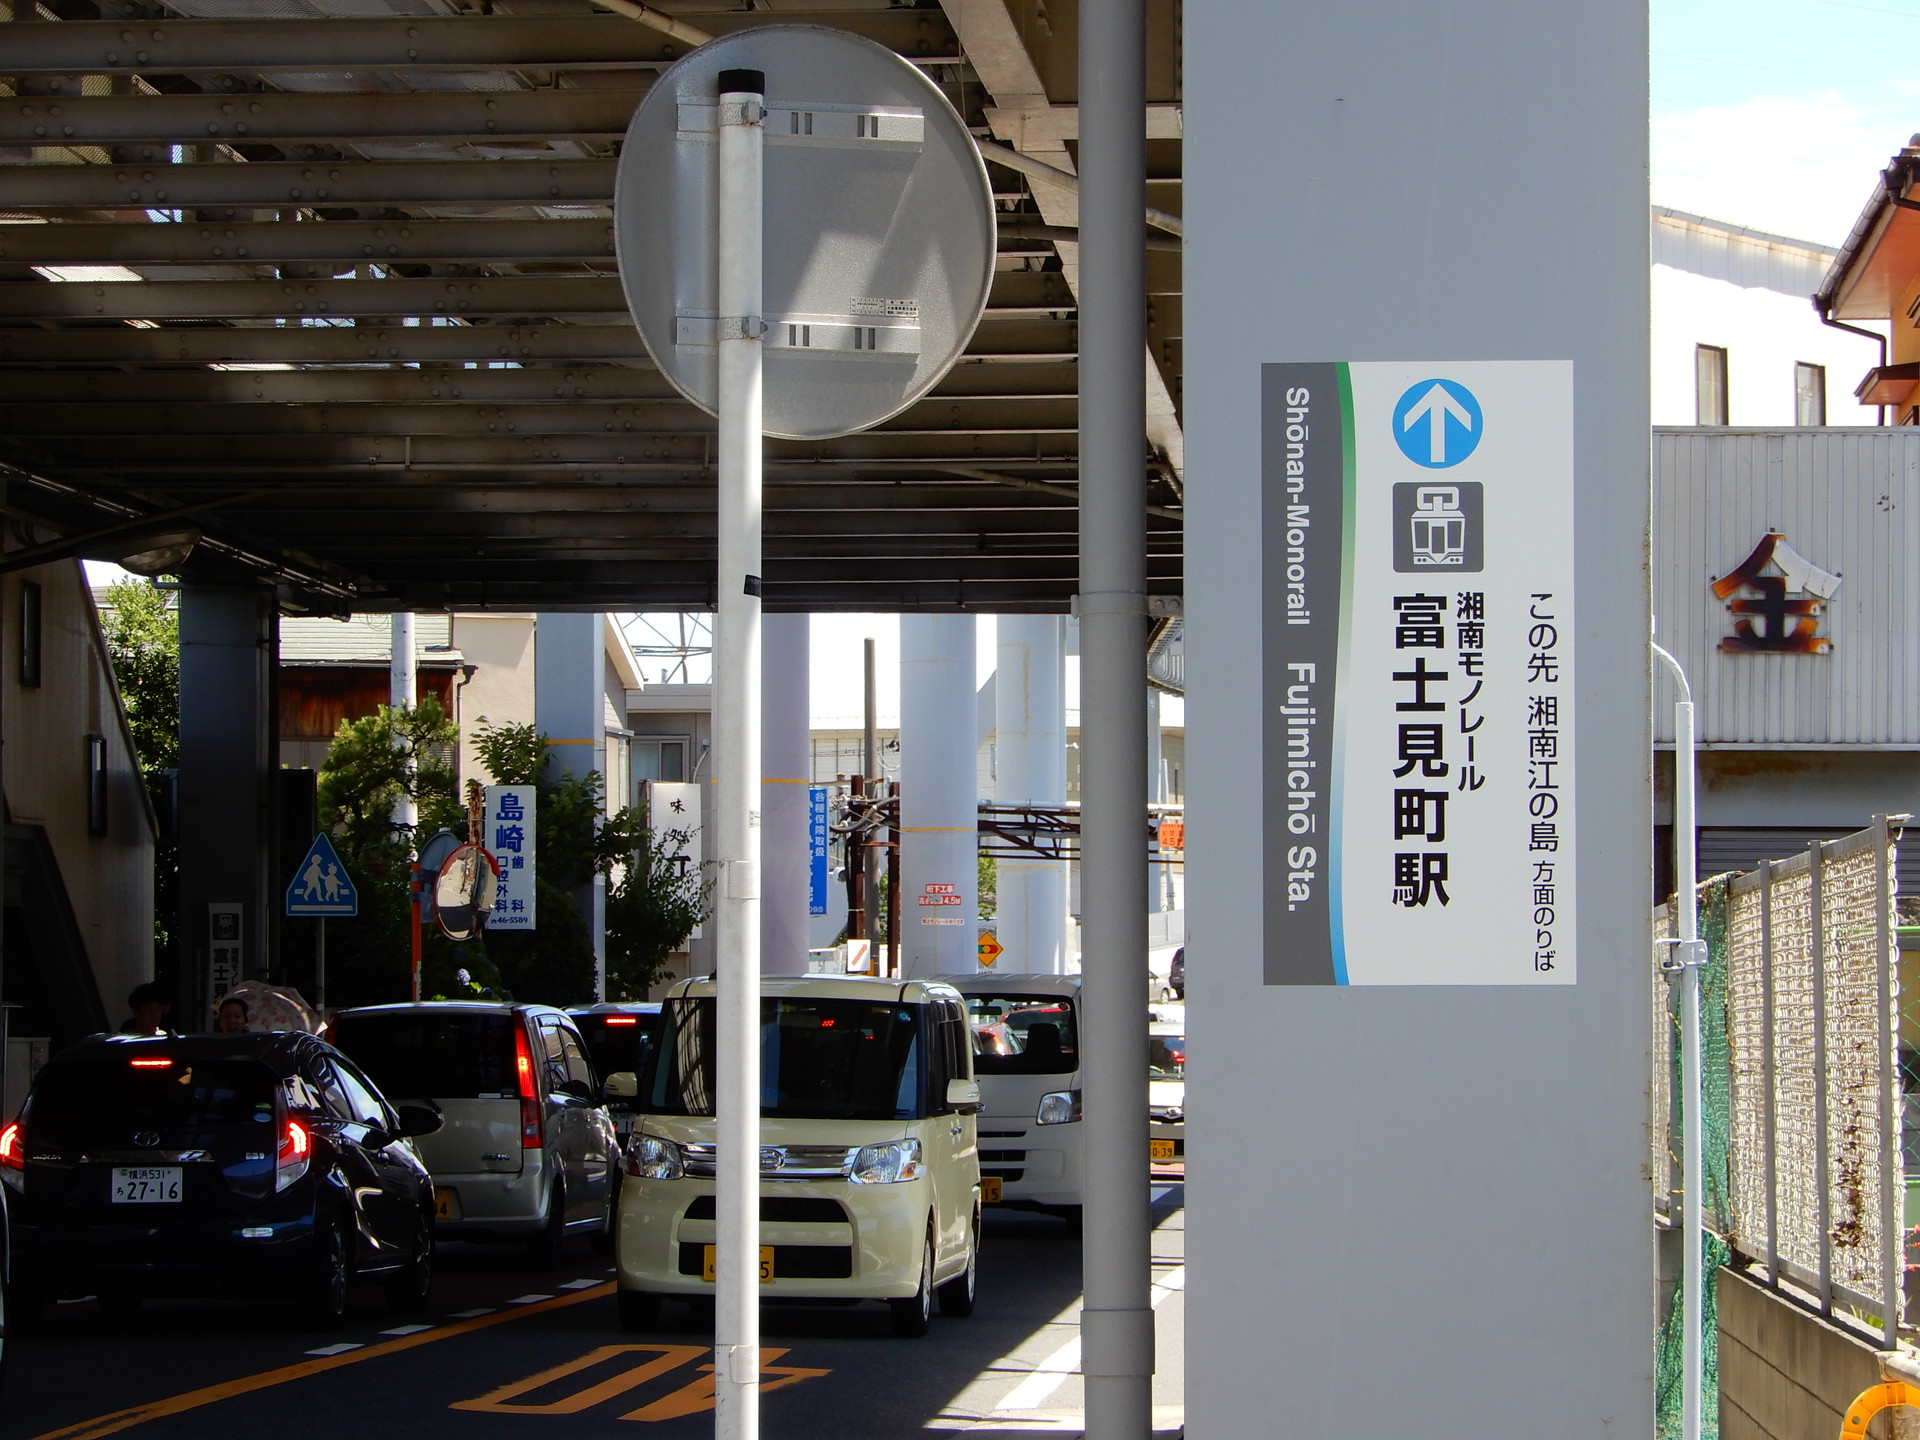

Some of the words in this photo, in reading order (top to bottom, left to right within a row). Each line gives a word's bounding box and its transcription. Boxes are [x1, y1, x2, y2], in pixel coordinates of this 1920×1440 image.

[1286, 387, 1310, 625] Shōnan-Monorail
[1280, 662, 1316, 834] Fujimichō
[1392, 593, 1450, 908] 富士見町駅
[1456, 591, 1486, 793] 湘南モノレール
[496, 792, 525, 853] 島崎
[815, 792, 825, 857] 各種保険取扱
[1287, 845, 1317, 912] Sta.
[127, 1182, 179, 1200] 27-16
